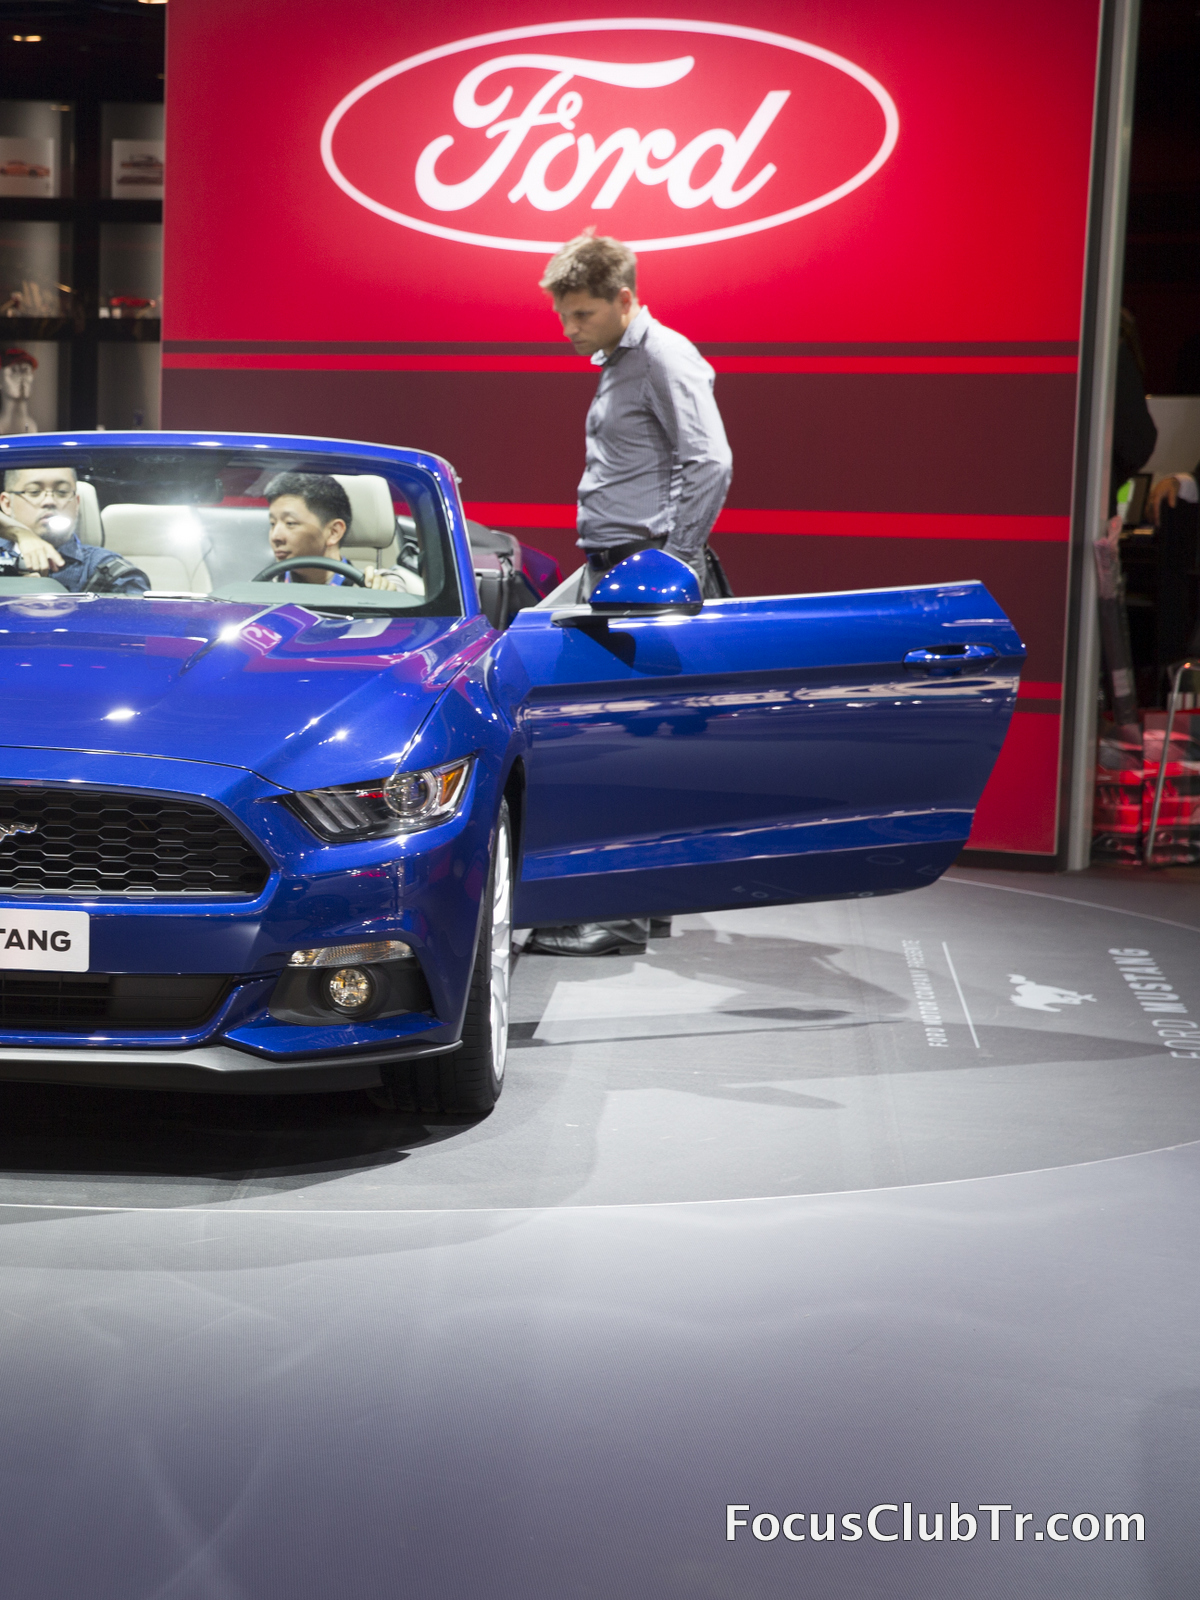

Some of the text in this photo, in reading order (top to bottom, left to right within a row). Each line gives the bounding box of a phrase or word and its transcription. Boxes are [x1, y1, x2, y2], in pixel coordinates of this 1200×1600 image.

[415, 53, 792, 212] Ford
[1107, 947, 1188, 1013] MUSTANG
[917, 1001, 943, 1026] MOTOR
[924, 1027, 949, 1048] FORD
